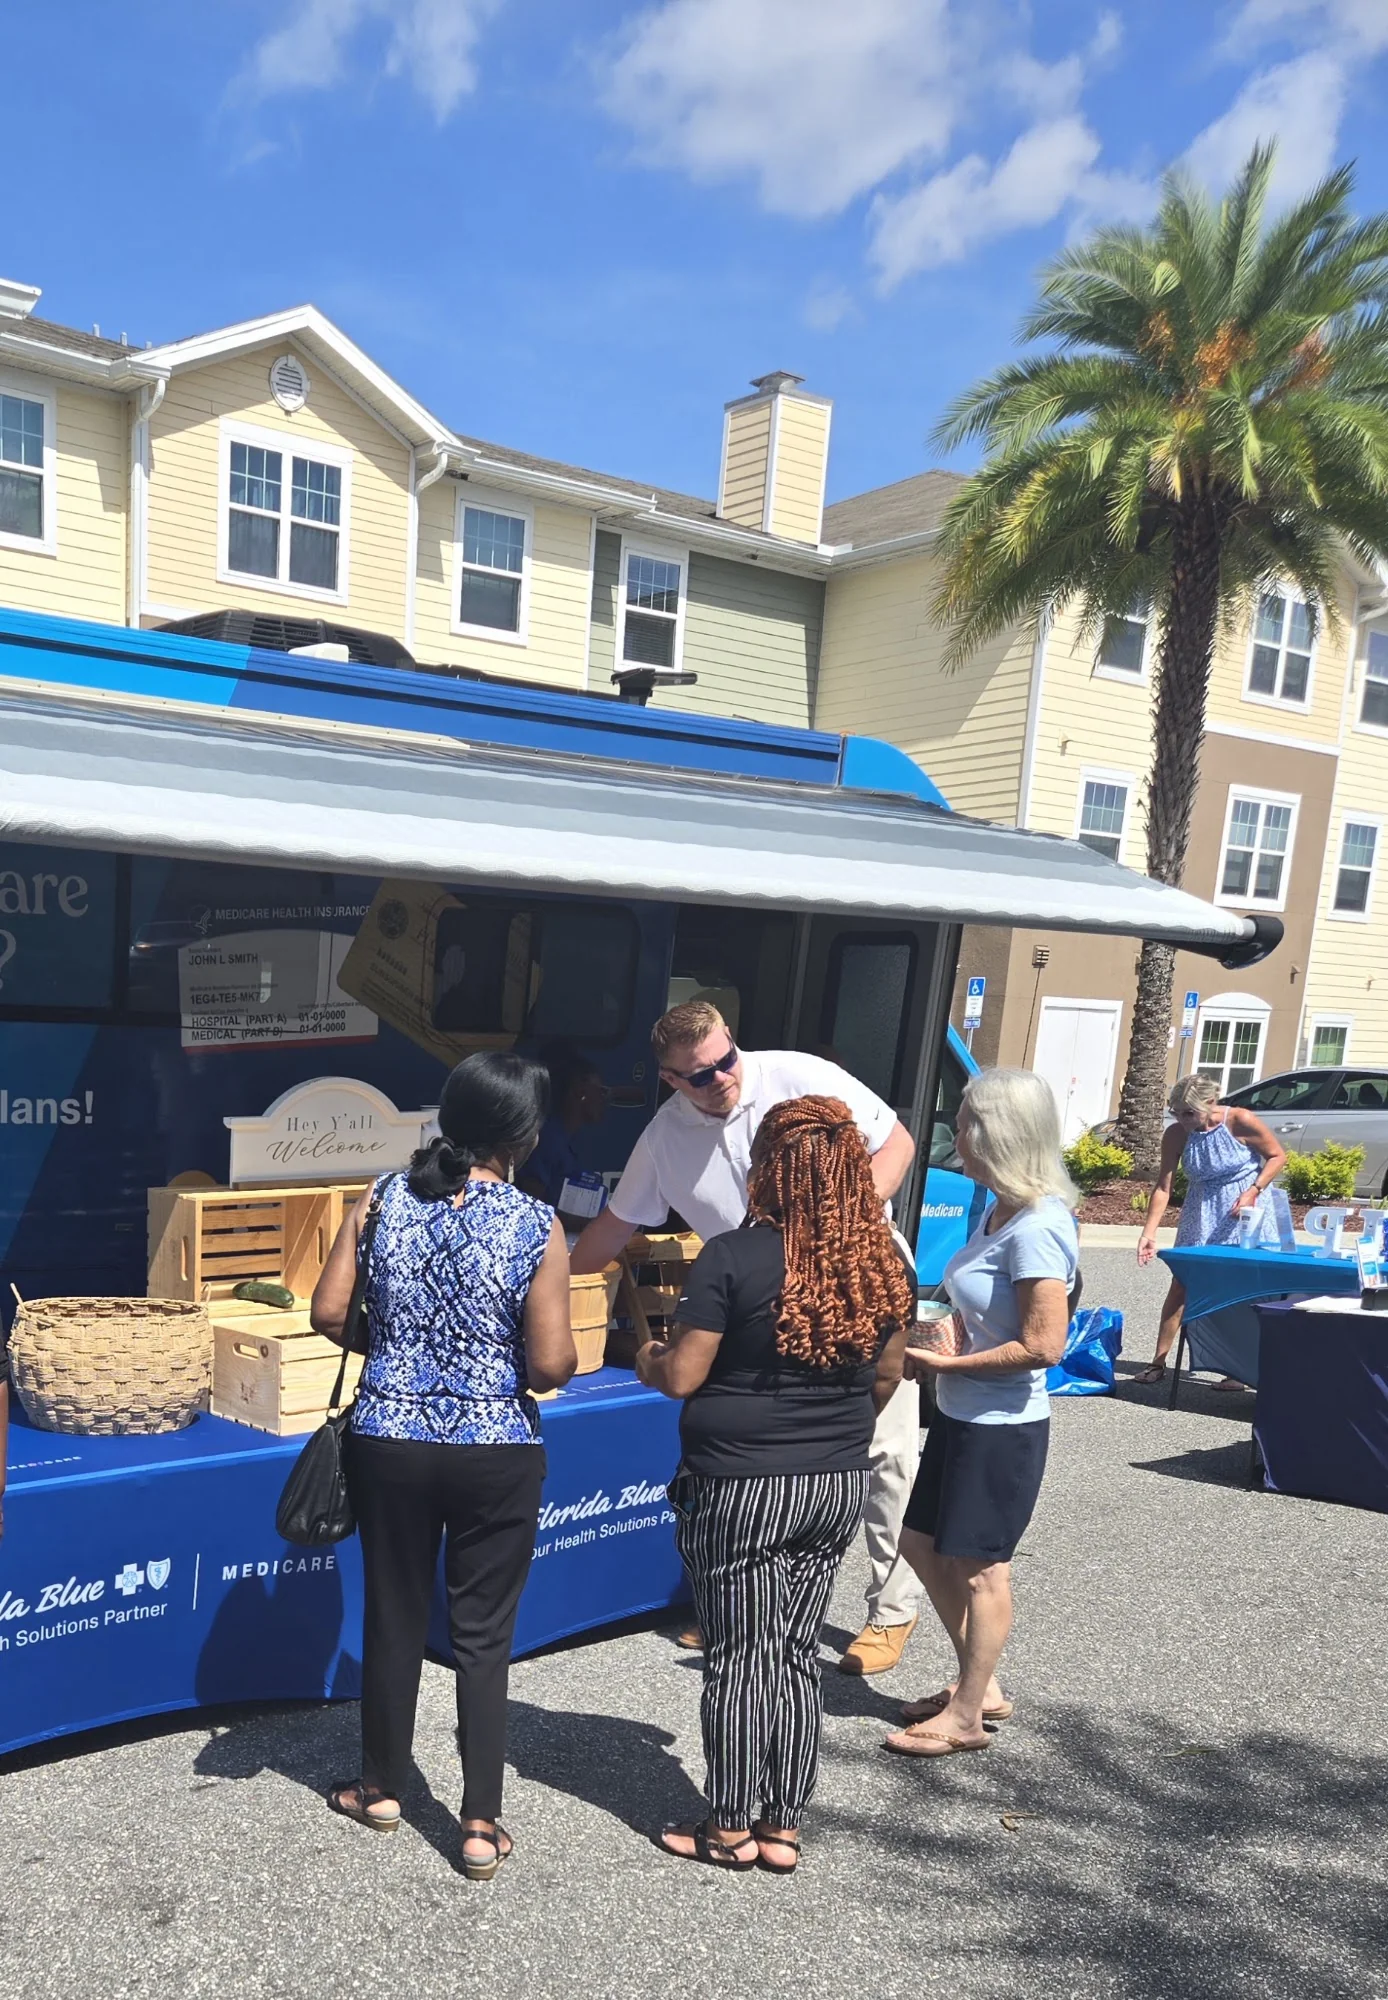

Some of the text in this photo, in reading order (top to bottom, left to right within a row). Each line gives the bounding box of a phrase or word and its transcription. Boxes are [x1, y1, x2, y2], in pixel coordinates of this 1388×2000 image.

[215, 908, 270, 920] MEDICARE
[272, 906, 312, 919] HEALTH
[188, 953, 259, 966] JOHN L SMITH
[191, 1022, 346, 1041] MEDICAL (PART B) 01-01-0000
[192, 1010, 346, 1028] HOSPITAL (PART A) 01-01-0000
[0, 1089, 94, 1125] lans!
[287, 1117, 320, 1134] Hey
[265, 1131, 388, 1164] Welcome
[920, 1203, 964, 1218] Medicare
[615, 1479, 667, 1510] Blue
[554, 1527, 596, 1552] Health
[599, 1515, 658, 1539] Solutions
[221, 1555, 336, 1581] MEDICARE
[34, 1576, 105, 1615] Blue
[15, 1616, 99, 1648] Solutions
[104, 1603, 168, 1626] Partner
